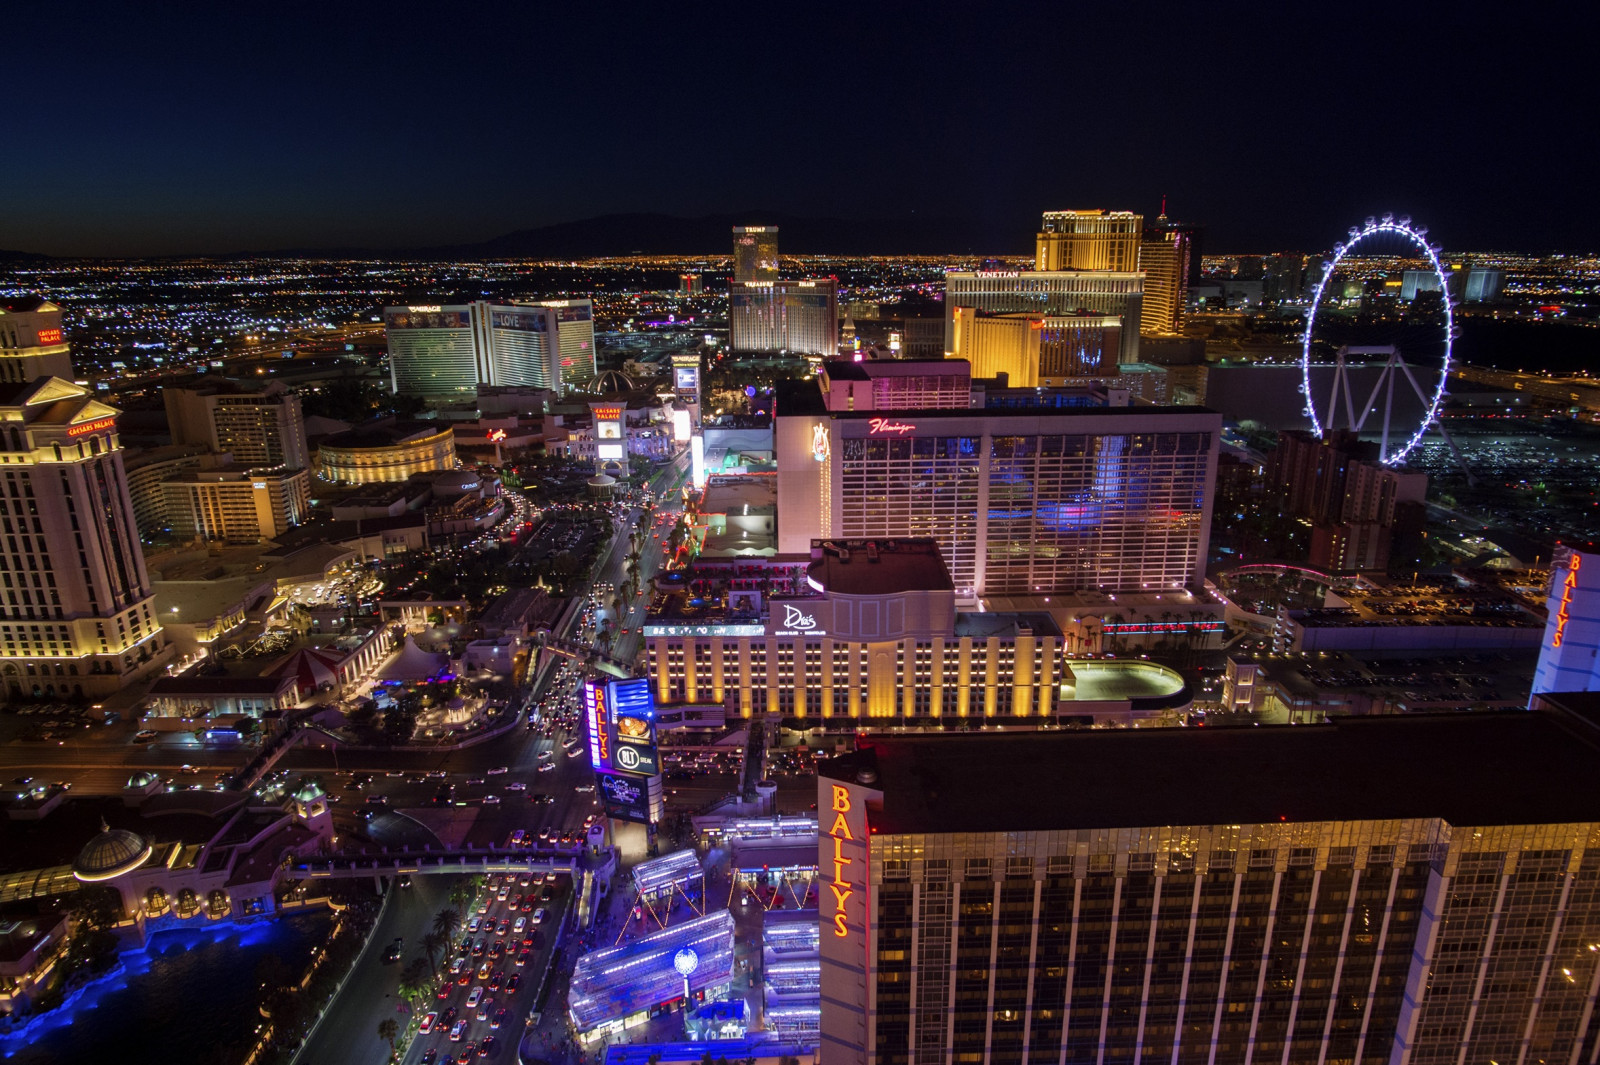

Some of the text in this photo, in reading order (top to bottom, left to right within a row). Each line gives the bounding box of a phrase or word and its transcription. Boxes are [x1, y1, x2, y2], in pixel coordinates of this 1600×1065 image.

[500, 314, 520, 327] LOVE
[68, 418, 115, 436] CAESARS PALACE
[868, 418, 916, 434] Flamingo
[621, 750, 635, 765] BLT
